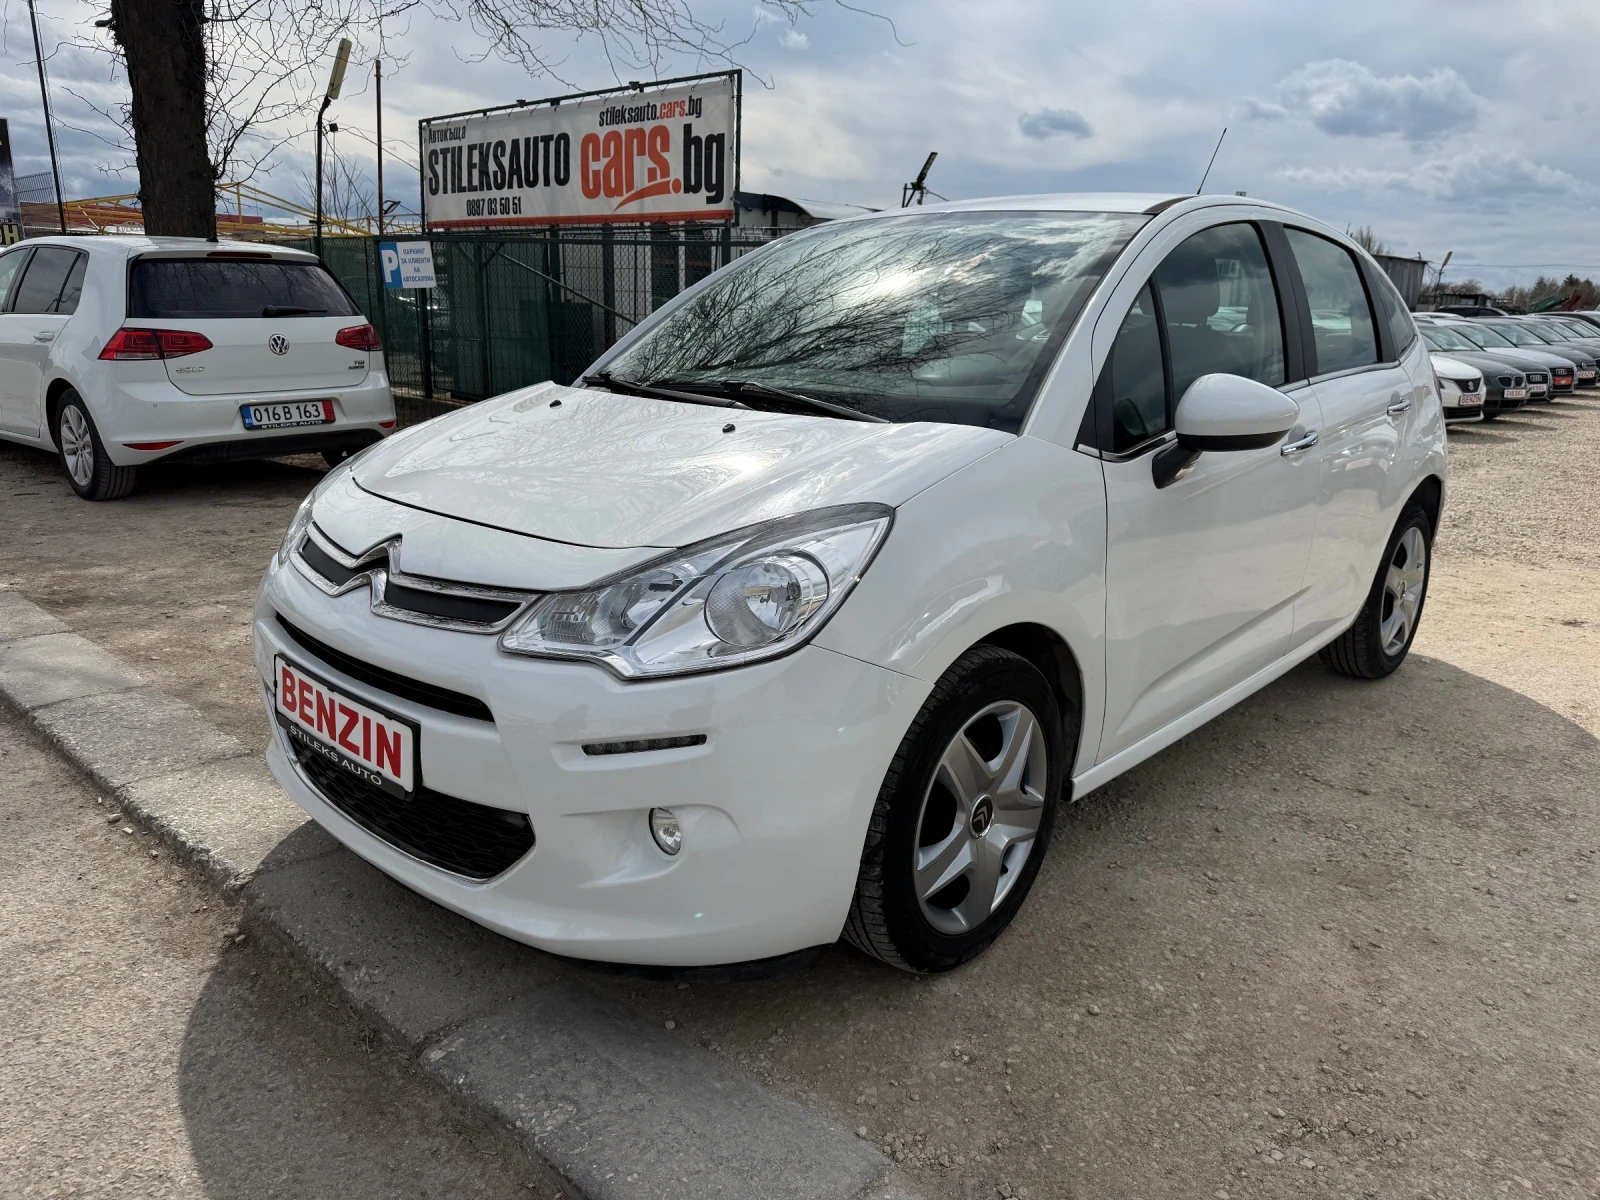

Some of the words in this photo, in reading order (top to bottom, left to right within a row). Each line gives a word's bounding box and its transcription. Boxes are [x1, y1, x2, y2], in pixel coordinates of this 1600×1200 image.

[599, 95, 703, 127] stileksauto.cars.bg
[428, 125, 467, 144] Автокъща
[428, 132, 571, 196] STILEKSAUTO
[580, 123, 726, 205] cars.bg
[466, 198, 485, 216] 0897
[487, 197, 498, 215] 03
[499, 196, 510, 215] 50
[512, 195, 522, 214] 51
[408, 256, 431, 264] КЛИЕНТИ
[402, 275, 435, 283] АВТОСАЛОНА
[1461, 395, 1482, 404] BENZIN
[253, 406, 281, 423] 016
[282, 405, 293, 420] B
[295, 403, 321, 419] 163
[281, 665, 402, 779] BENZIN
[289, 725, 339, 762] STILEKS
[341, 759, 382, 785] AUTO
